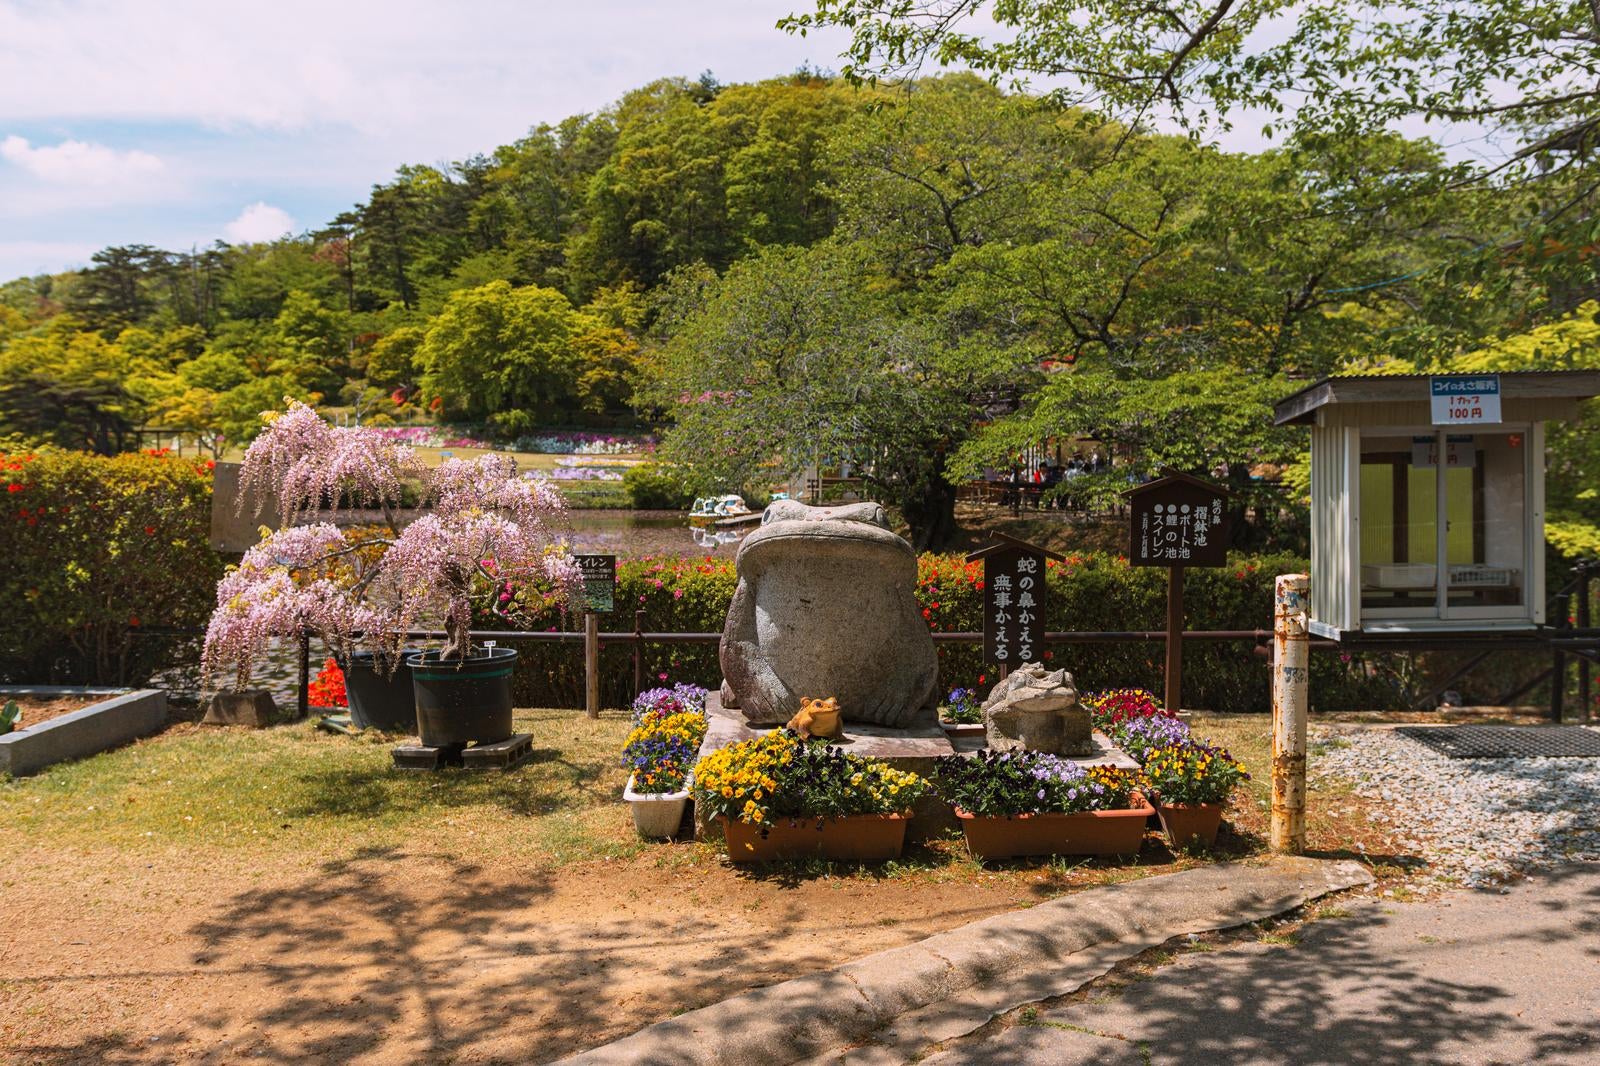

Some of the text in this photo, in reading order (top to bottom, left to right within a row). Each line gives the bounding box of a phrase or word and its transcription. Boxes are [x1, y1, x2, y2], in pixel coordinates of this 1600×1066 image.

[1434, 380, 1496, 391] コイのえさ販売
[1449, 408, 1482, 419] 100円
[1193, 506, 1208, 547] 摺鉢池
[1212, 498, 1222, 525] 蛇の鼻
[1152, 514, 1164, 558] スイレン
[1165, 514, 1178, 559] 鯉の池
[1178, 514, 1191, 559] ボート池
[993, 573, 1013, 660] 無事かえる
[1017, 556, 1037, 660] 蛇の鼻かえる
